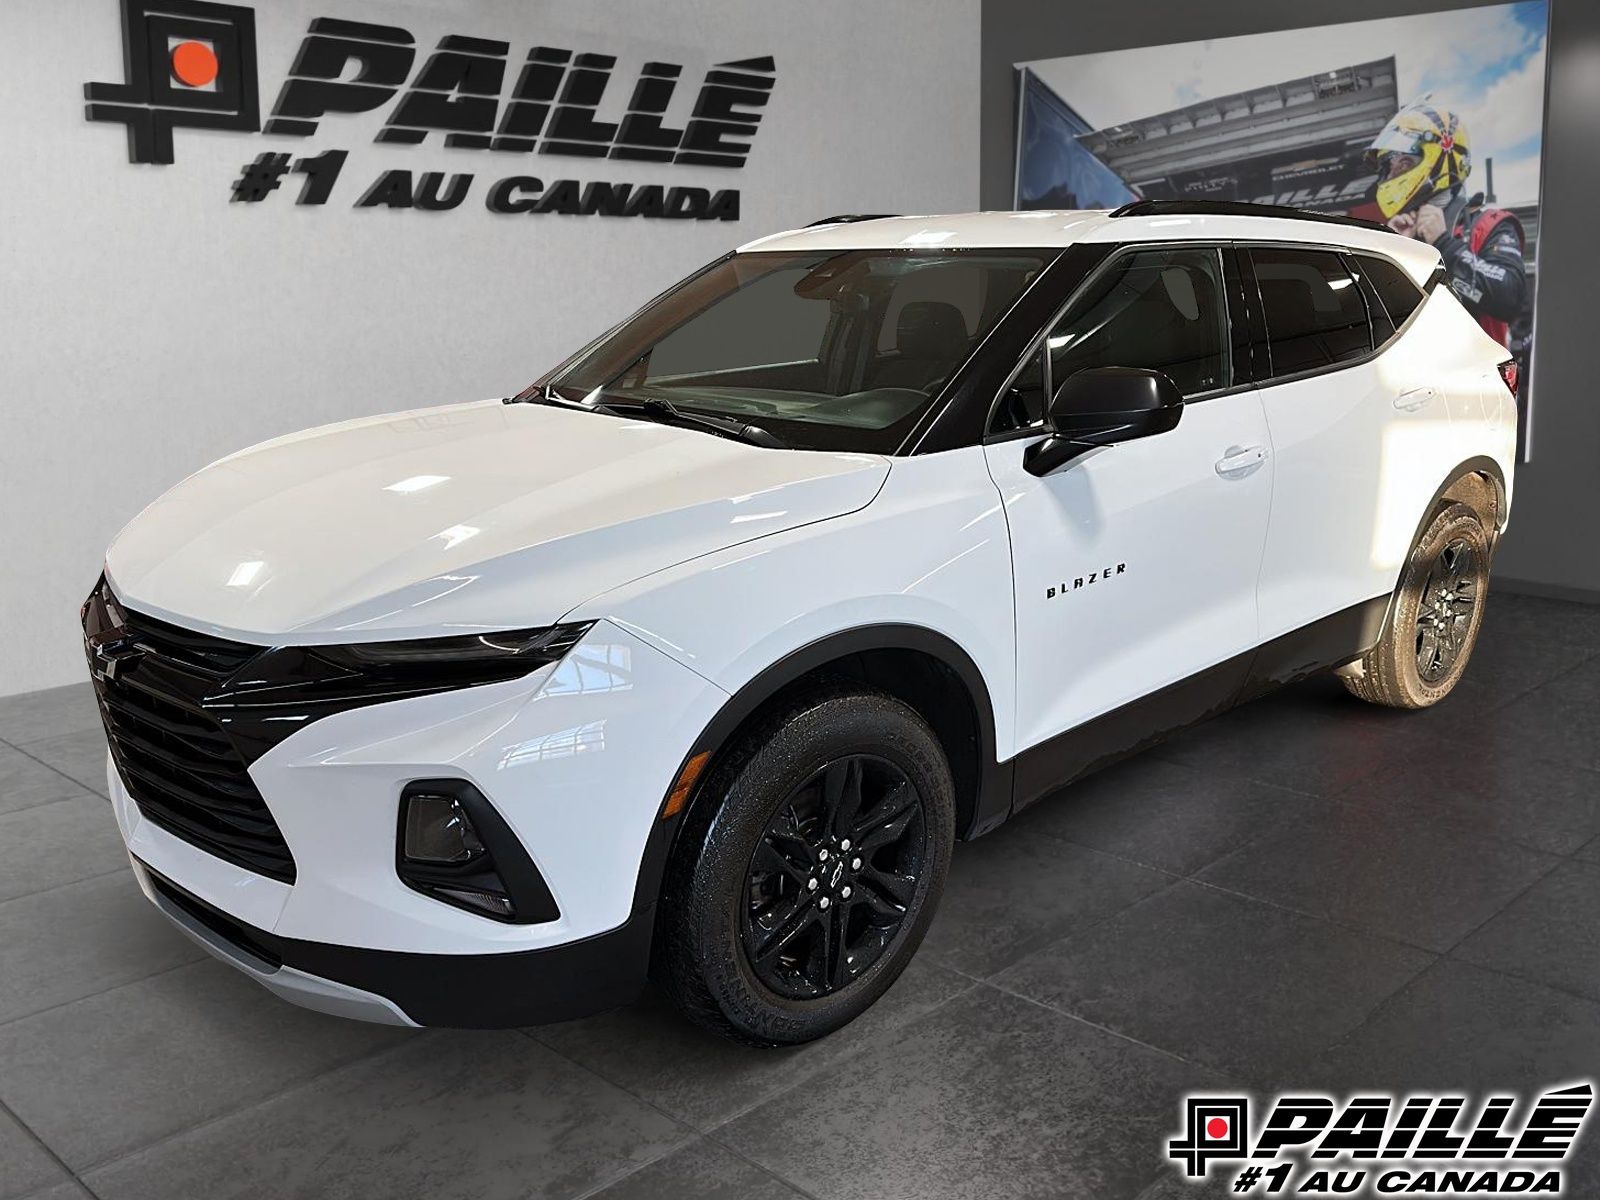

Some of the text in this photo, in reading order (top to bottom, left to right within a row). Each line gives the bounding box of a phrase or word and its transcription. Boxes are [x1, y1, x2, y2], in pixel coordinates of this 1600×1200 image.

[229, 149, 740, 221] #1 AU CANADA
[1045, 562, 1126, 599] BLAZER
